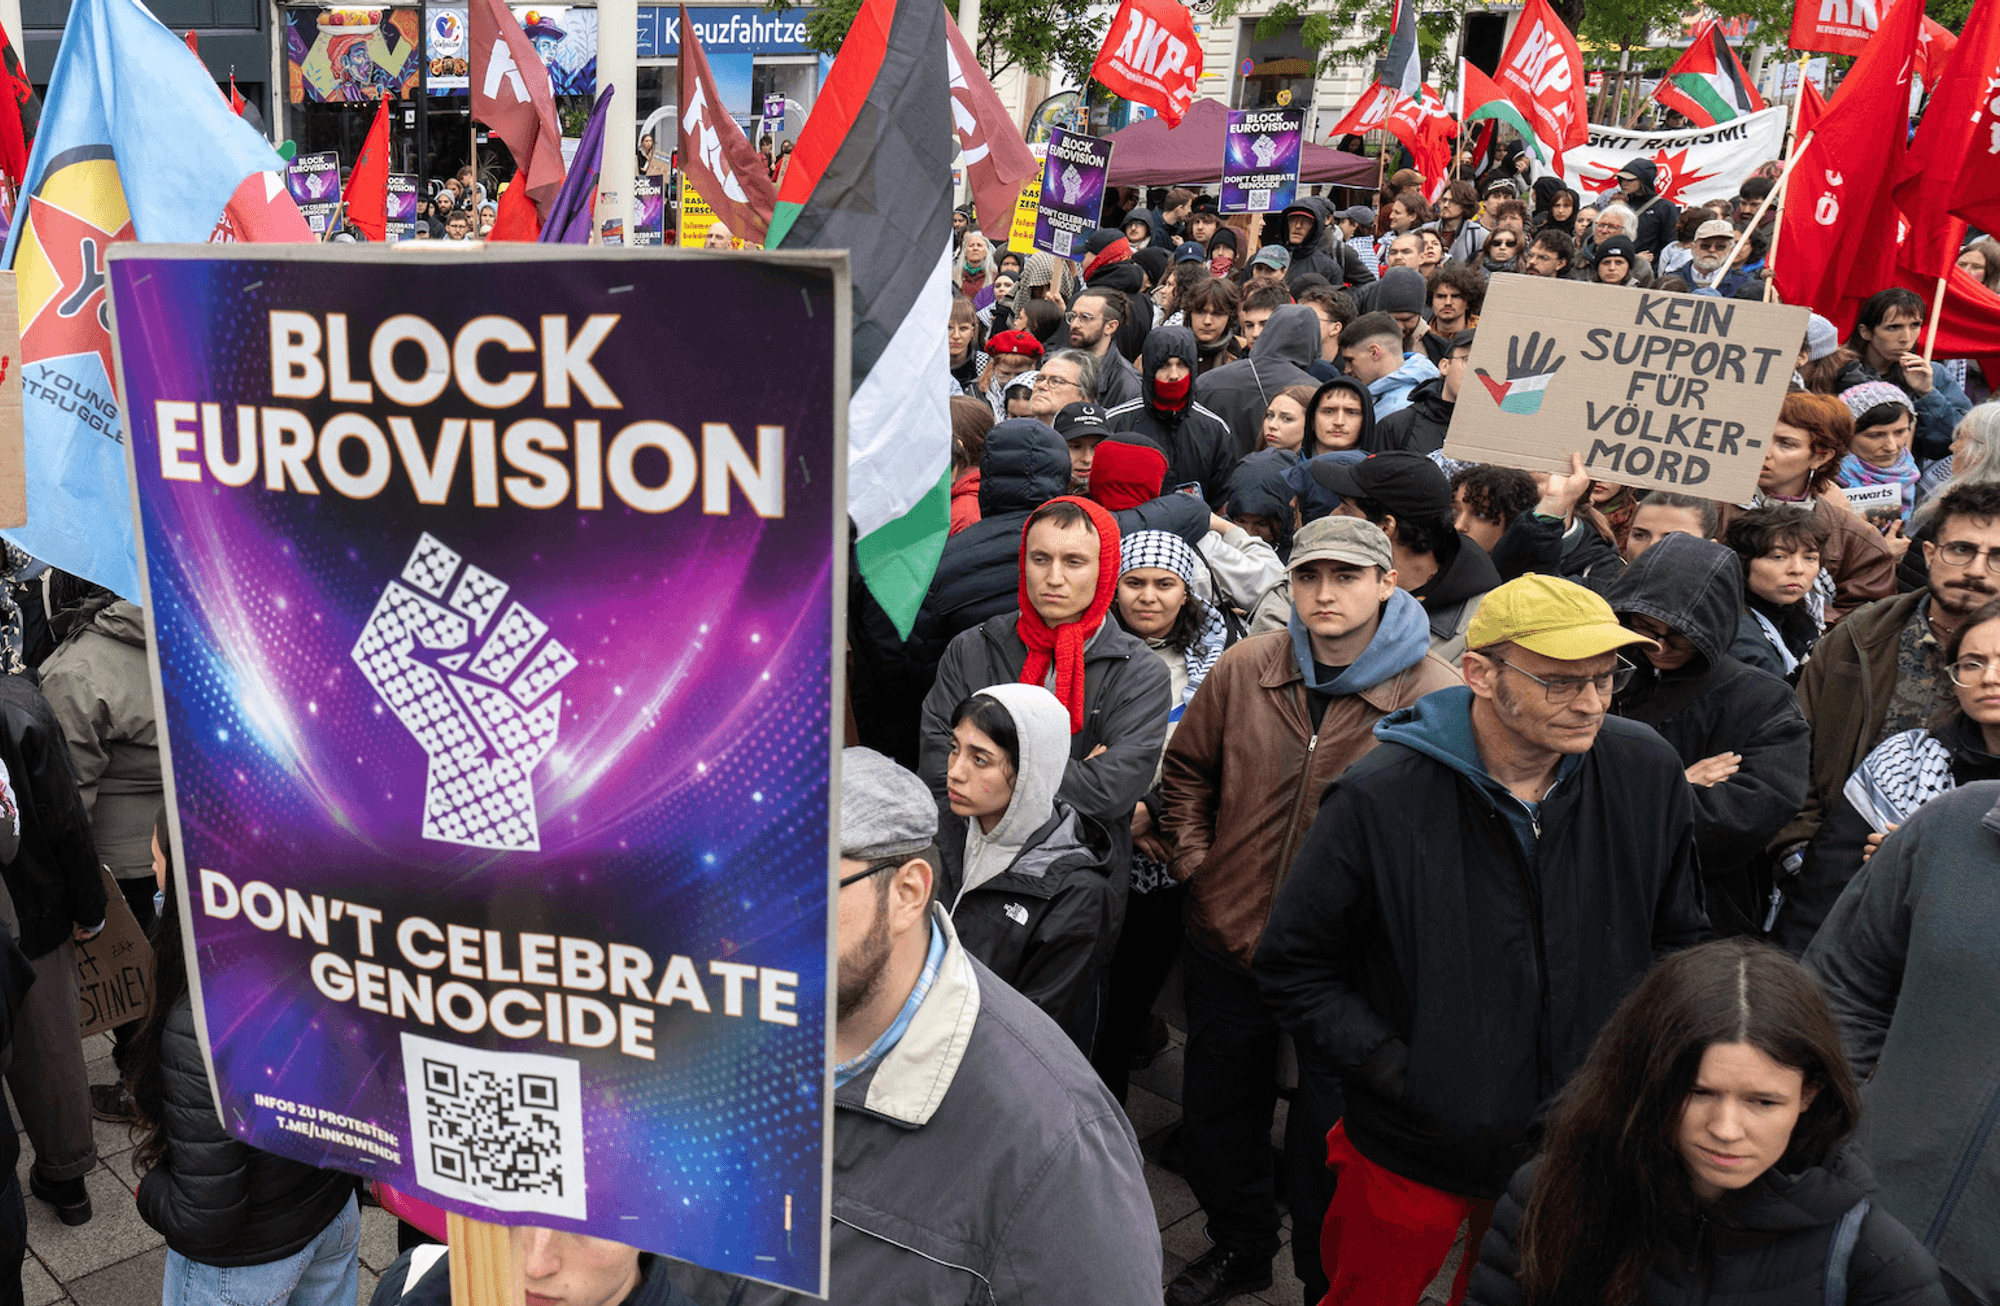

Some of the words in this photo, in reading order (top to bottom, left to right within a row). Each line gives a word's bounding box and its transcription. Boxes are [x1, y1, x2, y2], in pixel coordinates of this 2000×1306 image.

[665, 15, 811, 43] Keuzfahrtze
[1114, 7, 1188, 80] RKP
[1229, 121, 1299, 133] EUROVISION
[1246, 112, 1284, 123] BLOCK
[1061, 136, 1094, 154] BLOCK
[1640, 123, 1748, 150] RACISM!
[289, 162, 336, 173] EUROVISION
[298, 156, 325, 165] BLOCK
[1049, 144, 1105, 168] EUROVISION
[387, 177, 406, 185] OCK
[1238, 181, 1280, 189] GENOCIDE
[1251, 173, 1296, 182] CELEBRATE
[1048, 217, 1082, 233] GENOCIDE
[1057, 212, 1097, 229] CELEBRATE
[1634, 293, 1736, 338] KEIN
[269, 310, 624, 409] BLOCK
[1580, 328, 1782, 385] SUPPORT
[39, 364, 118, 420] YOUNG
[1626, 370, 1709, 411] FÜR
[1586, 400, 1762, 456] VÖLKER-
[154, 400, 785, 518] EUROVISION
[1585, 439, 1711, 486] MORD
[200, 868, 383, 958] DON'T
[396, 916, 799, 1027] CELEBRATE
[310, 951, 655, 1061] GENOCIDE
[254, 1093, 297, 1115] INFOS
[298, 1104, 317, 1119] ZU
[318, 1109, 399, 1147] PROTESTEN:
[276, 1115, 402, 1165] T.ME/LINKSWENDE
